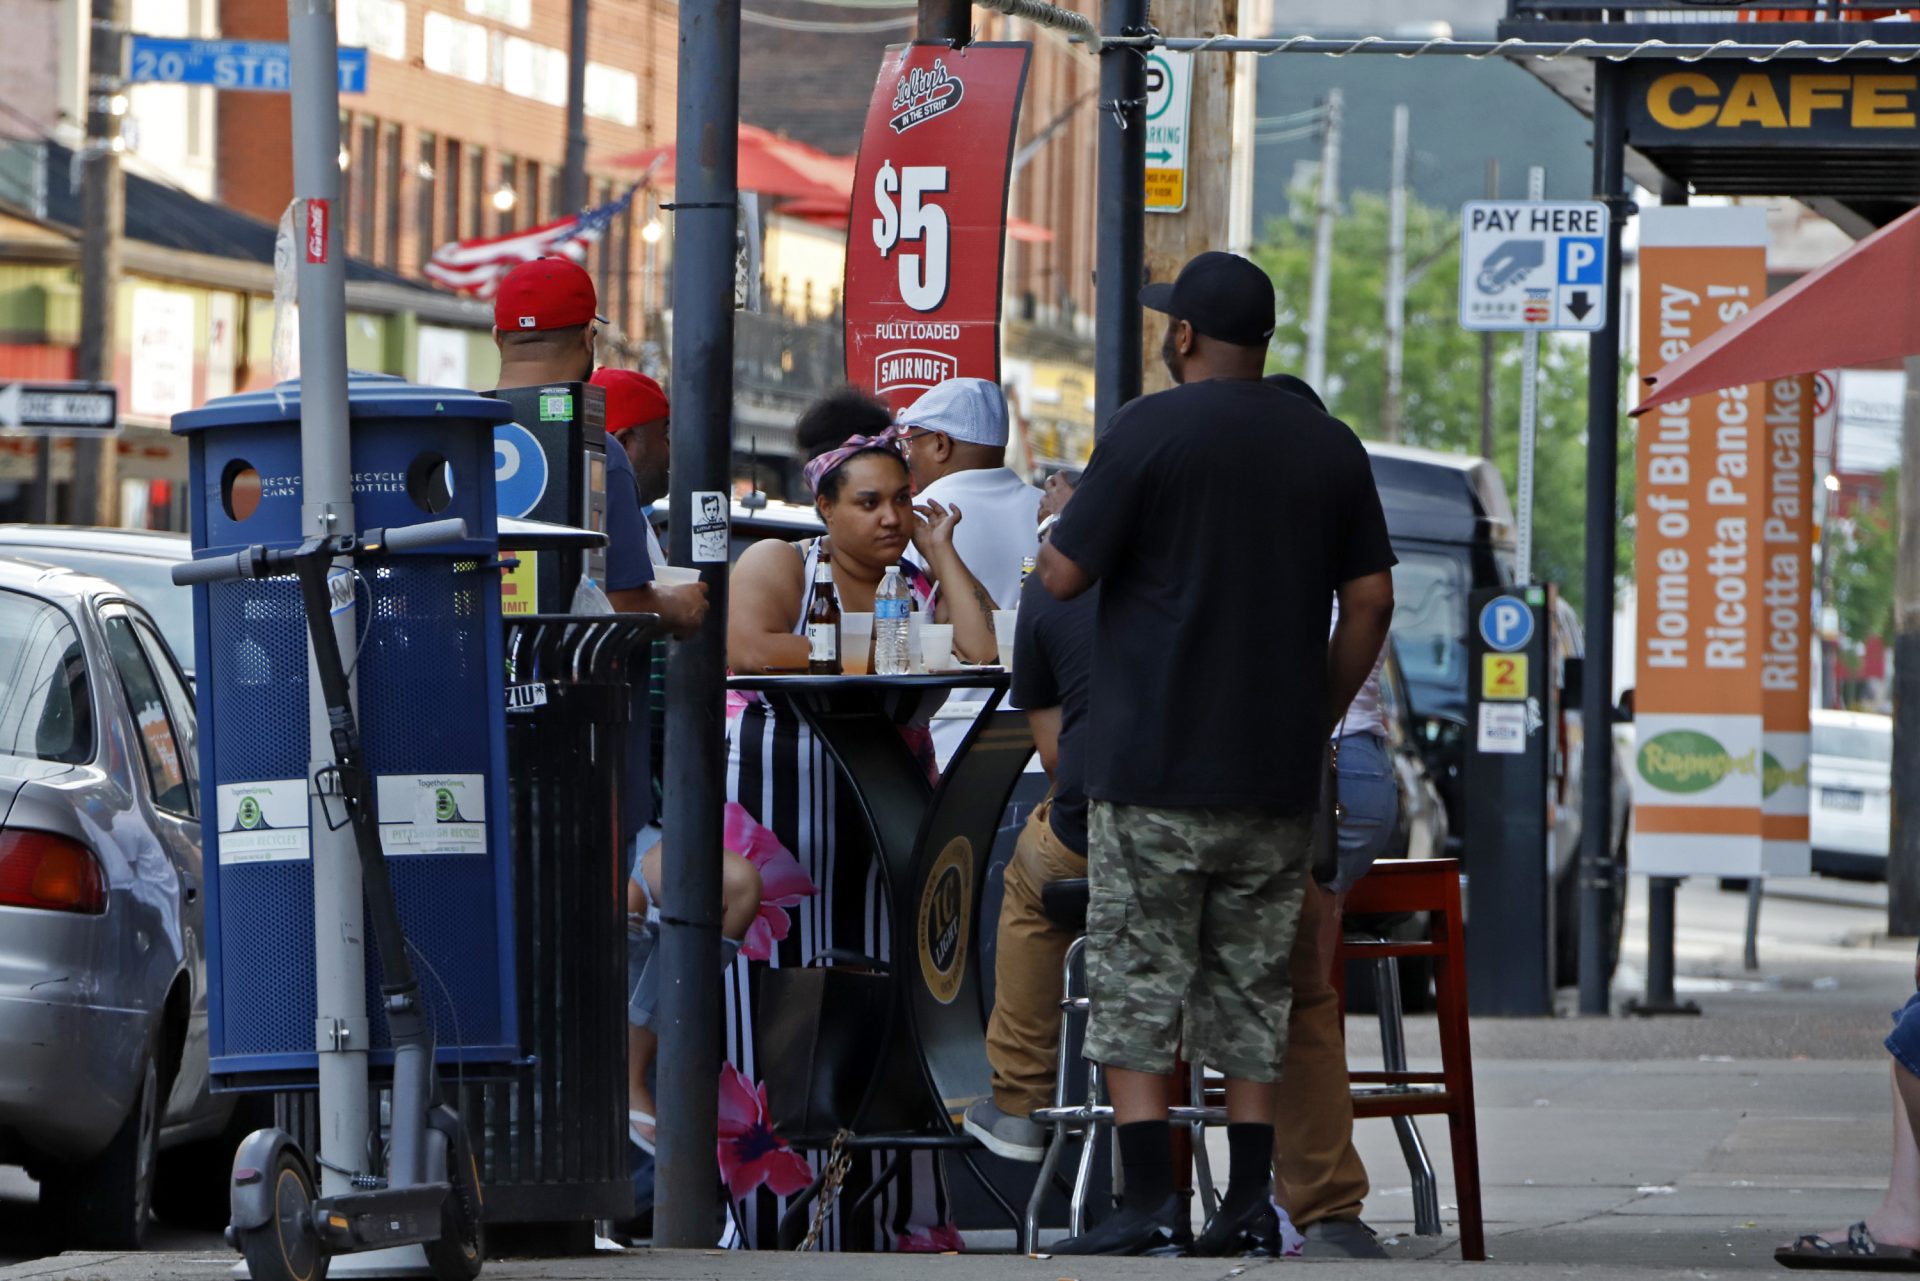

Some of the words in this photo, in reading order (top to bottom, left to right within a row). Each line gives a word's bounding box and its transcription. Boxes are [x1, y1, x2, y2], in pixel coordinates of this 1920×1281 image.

[213, 54, 358, 91] STRT
[893, 58, 947, 111] Lefty's
[902, 115, 911, 126] IN
[910, 107, 923, 120] THE
[923, 98, 947, 116] STRIP
[1646, 72, 1918, 130] CAFE
[1146, 127, 1181, 145] RKING
[872, 159, 949, 313] $5
[1473, 208, 1521, 232] PAY
[1531, 208, 1599, 233] HERE
[1566, 241, 1596, 282] P
[875, 323, 909, 340] FULLY
[910, 323, 960, 340] LOADED
[881, 357, 949, 384] SMIRNOFF
[1648, 282, 1701, 485] Blueerry
[1763, 375, 1801, 543] Pancake
[262, 475, 302, 486] RECYC
[262, 487, 296, 497] CANS
[1647, 494, 1690, 538] of
[503, 601, 528, 613] IMIT
[1647, 547, 1690, 668] Home
[1704, 516, 1748, 669] Ricotta
[1495, 605, 1521, 643] P
[1760, 552, 1800, 691] Ricotta
[1495, 659, 1517, 686] 2
[935, 916, 959, 967] LIGHT
